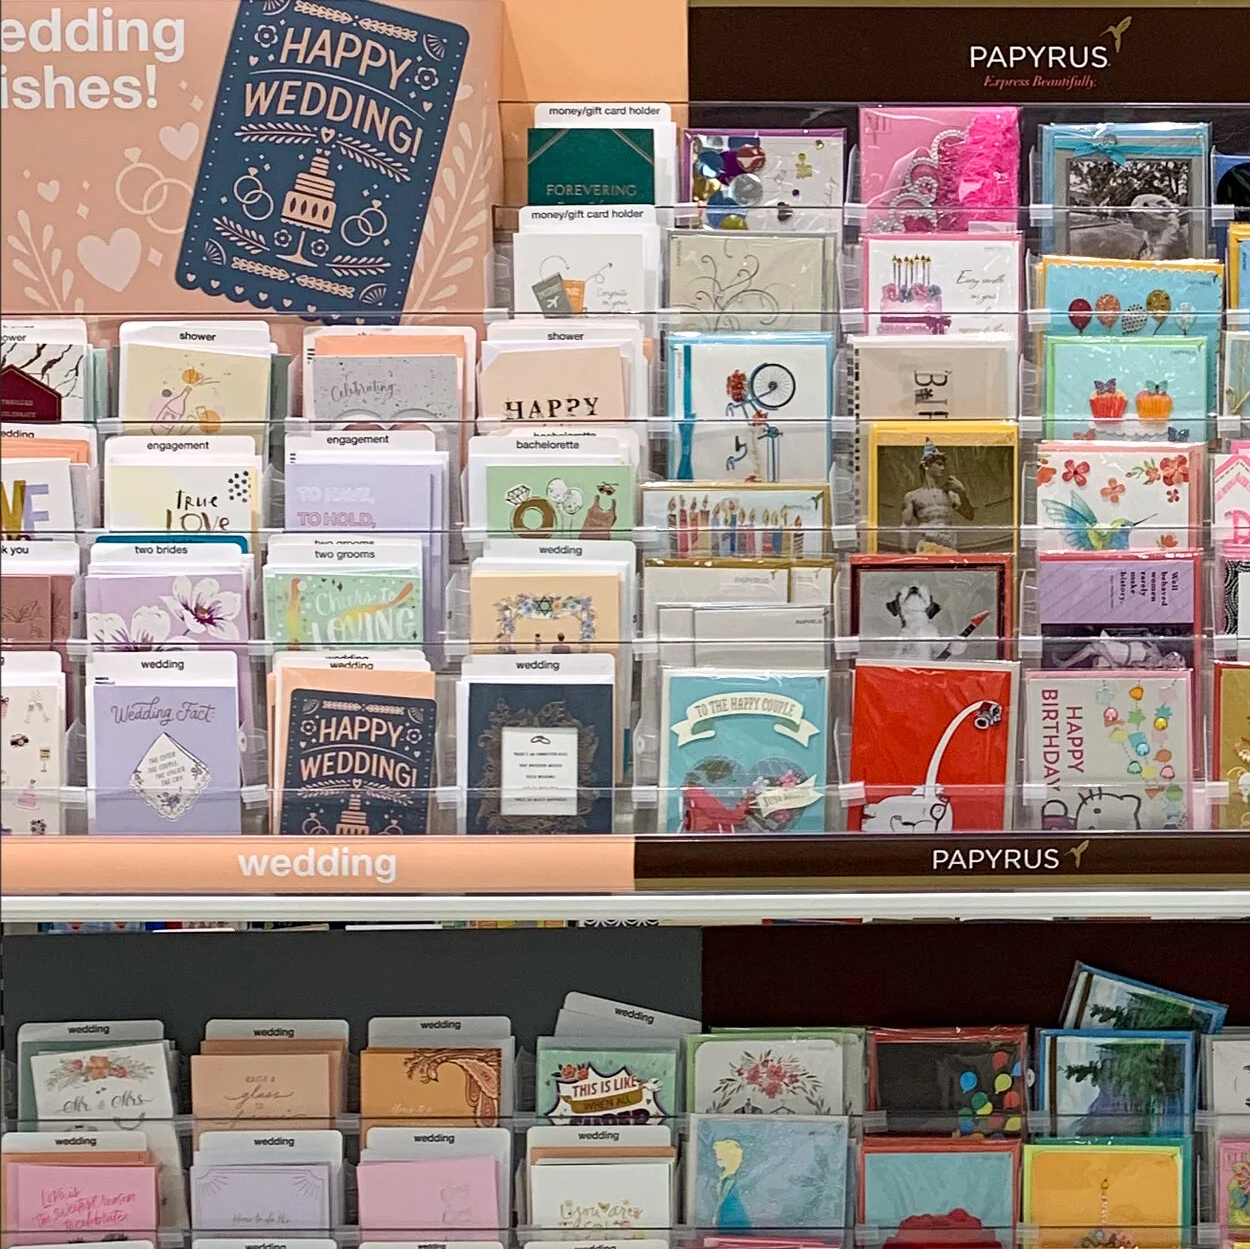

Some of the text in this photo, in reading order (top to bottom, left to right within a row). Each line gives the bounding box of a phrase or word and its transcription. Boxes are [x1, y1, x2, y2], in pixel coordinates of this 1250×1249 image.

[279, 26, 411, 91] HAPPY
[970, 45, 1109, 69] PAPYRUS
[983, 75, 1097, 90] Express Beautifully.
[549, 106, 660, 117] money/gift card holder
[244, 81, 423, 162] WEDDING!
[546, 184, 637, 196] FOREVERING
[531, 209, 644, 221] money/gift card holder
[179, 331, 216, 341] shower
[547, 332, 584, 341] shower
[504, 397, 599, 420] HAPPY
[147, 440, 209, 451] engagement
[326, 434, 389, 445] engagement
[516, 440, 580, 449] bachelorette
[297, 512, 376, 528] TO HOLD,
[10, 546, 29, 555] you
[135, 546, 188, 554] two brides
[315, 550, 375, 560] two grooms
[539, 546, 583, 556] wedding
[1130, 571, 1138, 595] make
[1139, 571, 1149, 597] rarely
[1171, 571, 1179, 591] Well
[1161, 571, 1169, 607] behaved
[141, 660, 184, 670] wedding
[330, 661, 374, 670] wedding
[516, 661, 560, 671] wedding
[111, 696, 174, 726] Wedding
[695, 697, 796, 718] TO THE HAPPY COUPLE
[319, 716, 404, 748] HAPPY
[1041, 689, 1061, 792] BIRTHDAY
[1066, 706, 1085, 774] HAPPY
[300, 751, 417, 788] WEDDING!
[237, 847, 398, 884] wedding
[932, 849, 1060, 870] PAPYRUS
[614, 1007, 655, 1025] wedding
[67, 1025, 110, 1035] wedding
[420, 1020, 462, 1031] wedding
[253, 1028, 295, 1038] wedding
[572, 1075, 637, 1098] THIS IS LIKE
[55, 1136, 97, 1147] wedding
[253, 1137, 295, 1147] wedding
[414, 1134, 455, 1144] wedding
[578, 1131, 620, 1141] wedding
